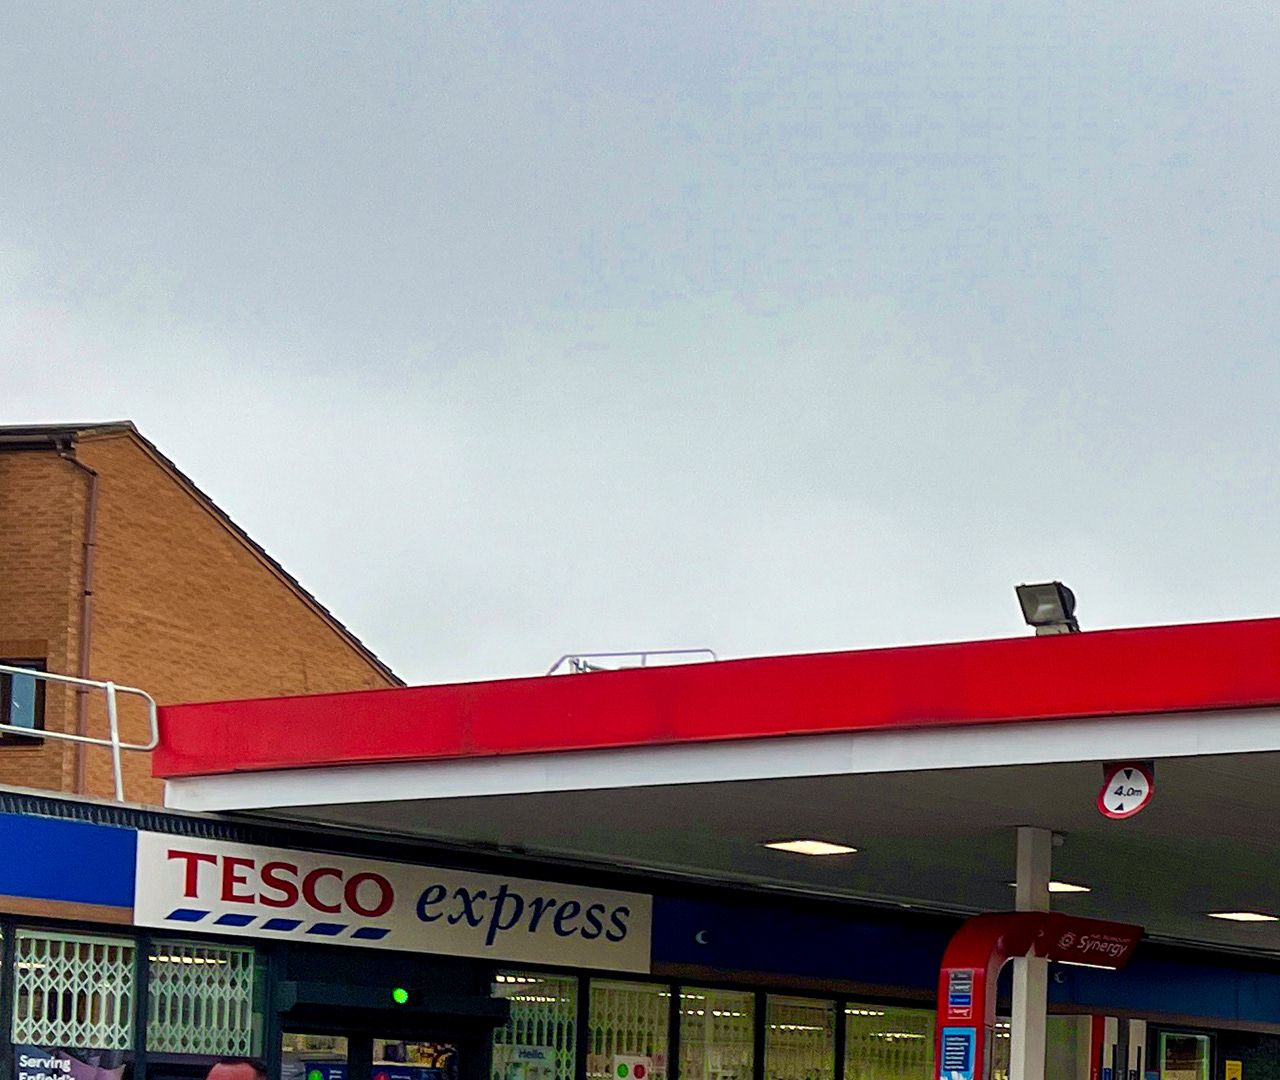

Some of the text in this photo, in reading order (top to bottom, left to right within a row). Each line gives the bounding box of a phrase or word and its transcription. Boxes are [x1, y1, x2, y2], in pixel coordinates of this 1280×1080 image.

[1114, 785, 1143, 797] 4.0m
[167, 849, 631, 946] TESCO express
[1077, 935, 1128, 957] Synergy
[19, 1054, 71, 1073] Serving
[518, 1049, 546, 1060] Hello.
